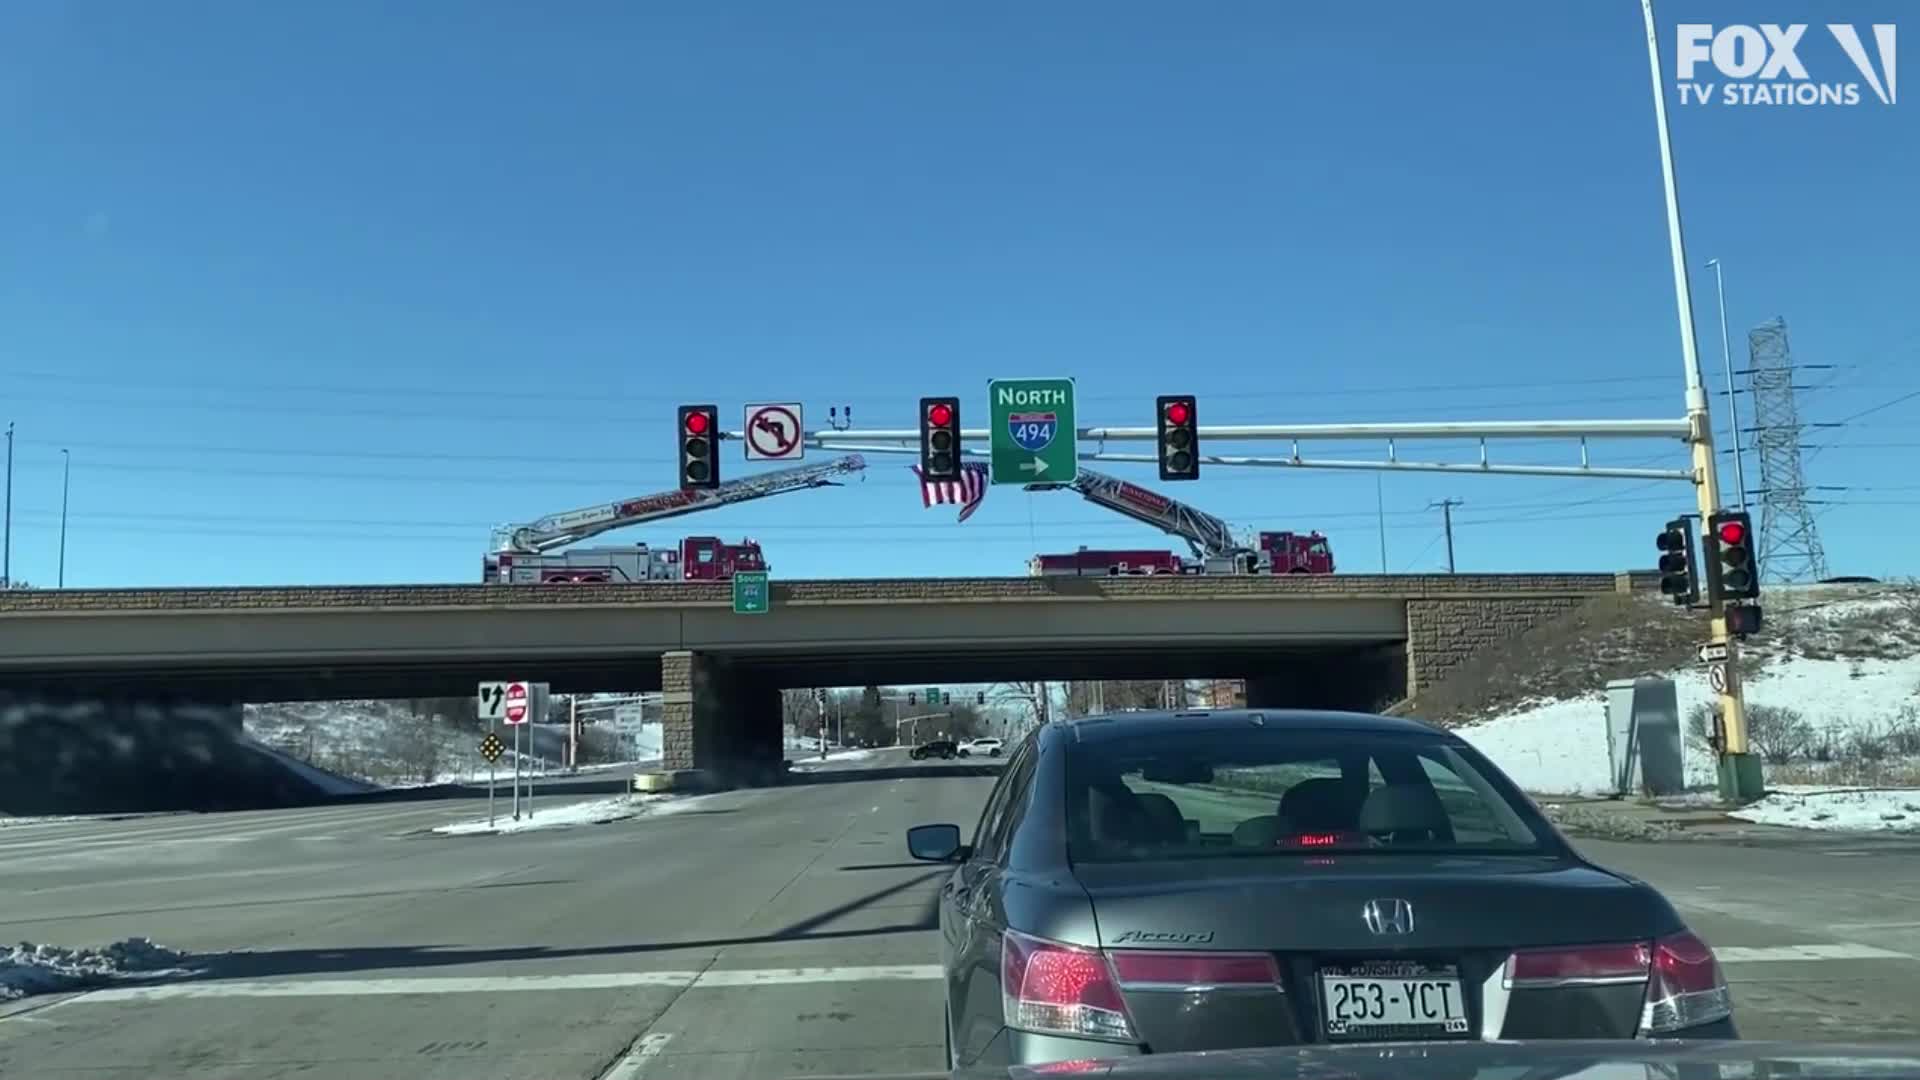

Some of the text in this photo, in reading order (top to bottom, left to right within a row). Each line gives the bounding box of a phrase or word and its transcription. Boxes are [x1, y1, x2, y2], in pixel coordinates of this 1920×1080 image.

[999, 387, 1065, 405] NORTH
[1016, 423, 1050, 441] 494
[1112, 930, 1215, 944] Accord
[1333, 983, 1453, 1020] 253-YCT
